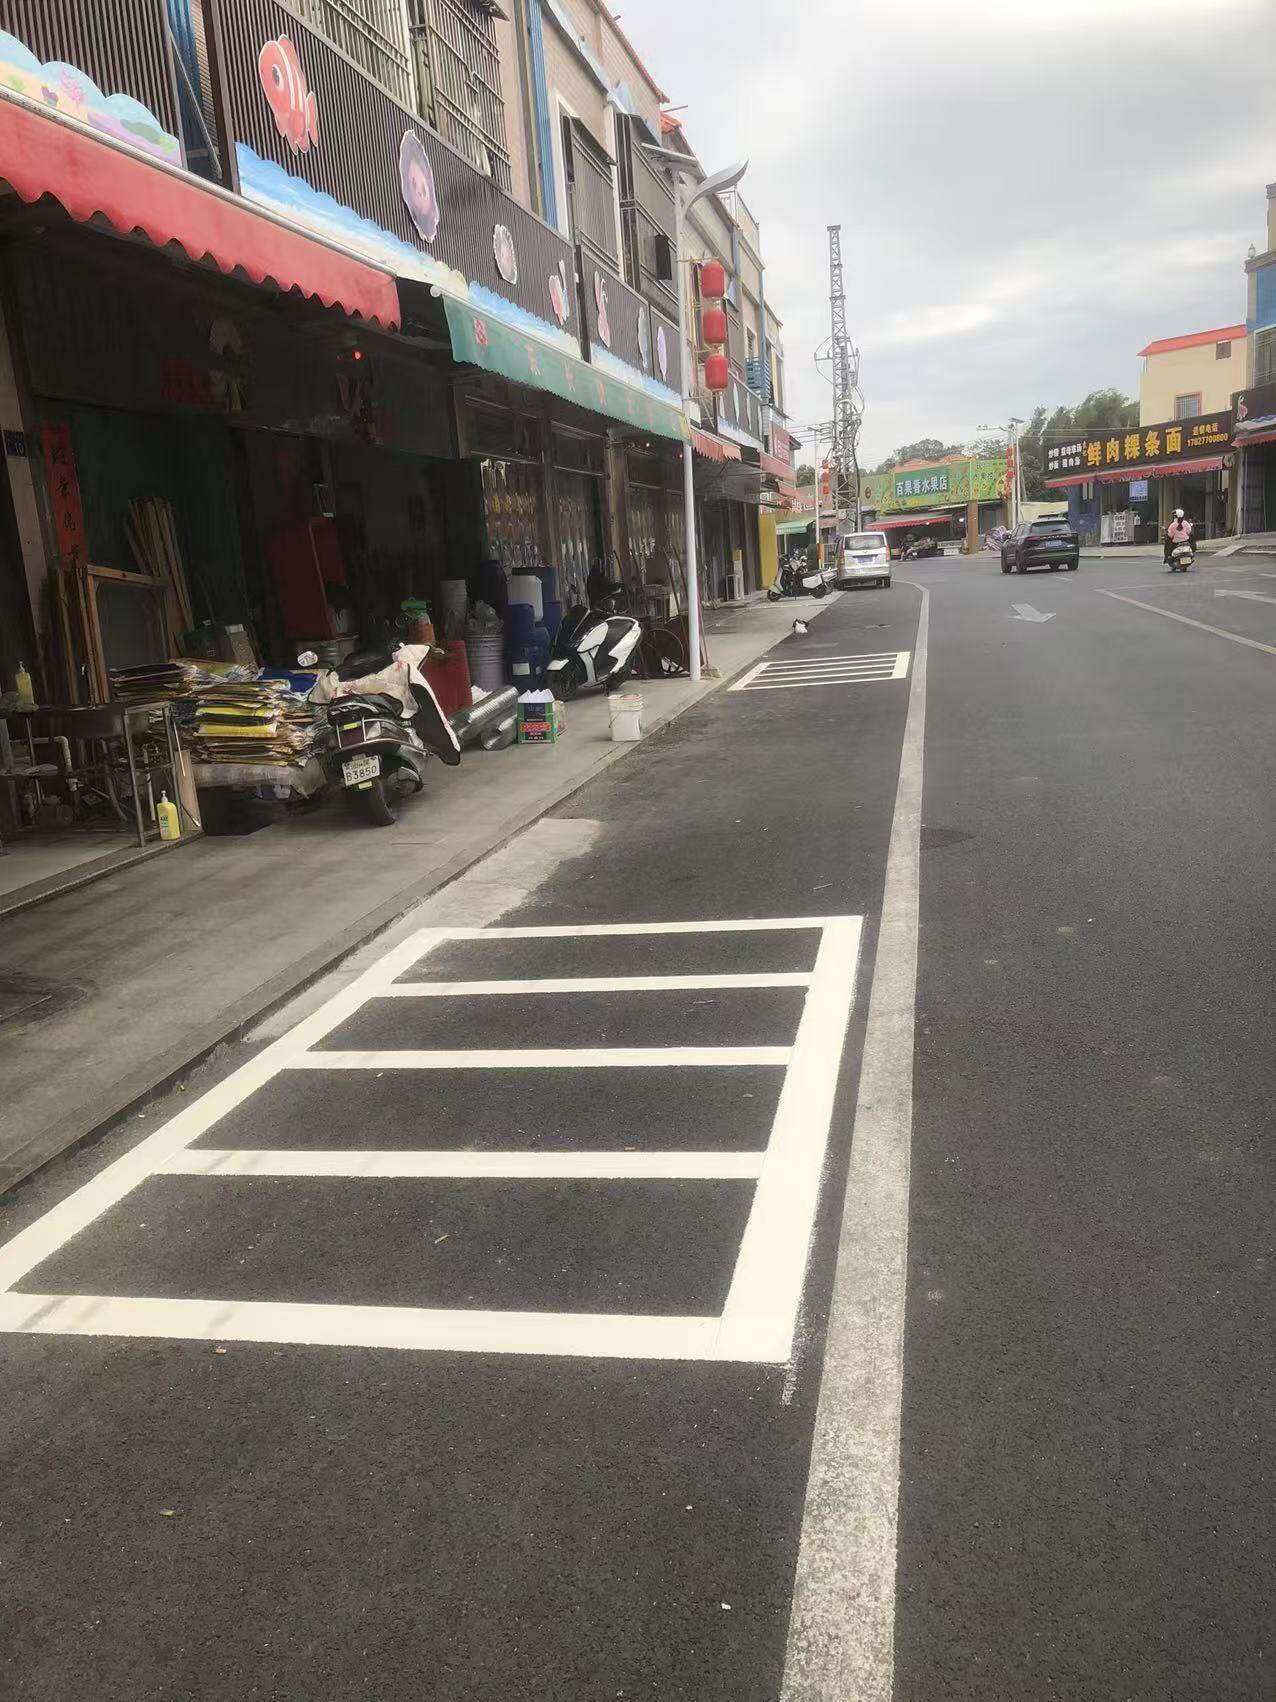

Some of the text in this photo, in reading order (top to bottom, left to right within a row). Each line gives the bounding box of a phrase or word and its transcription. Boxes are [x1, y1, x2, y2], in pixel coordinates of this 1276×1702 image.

[1087, 426, 1182, 466] 鲜肉粿条面
[896, 476, 948, 497] 百果香水果店
[346, 765, 377, 782] B3850
